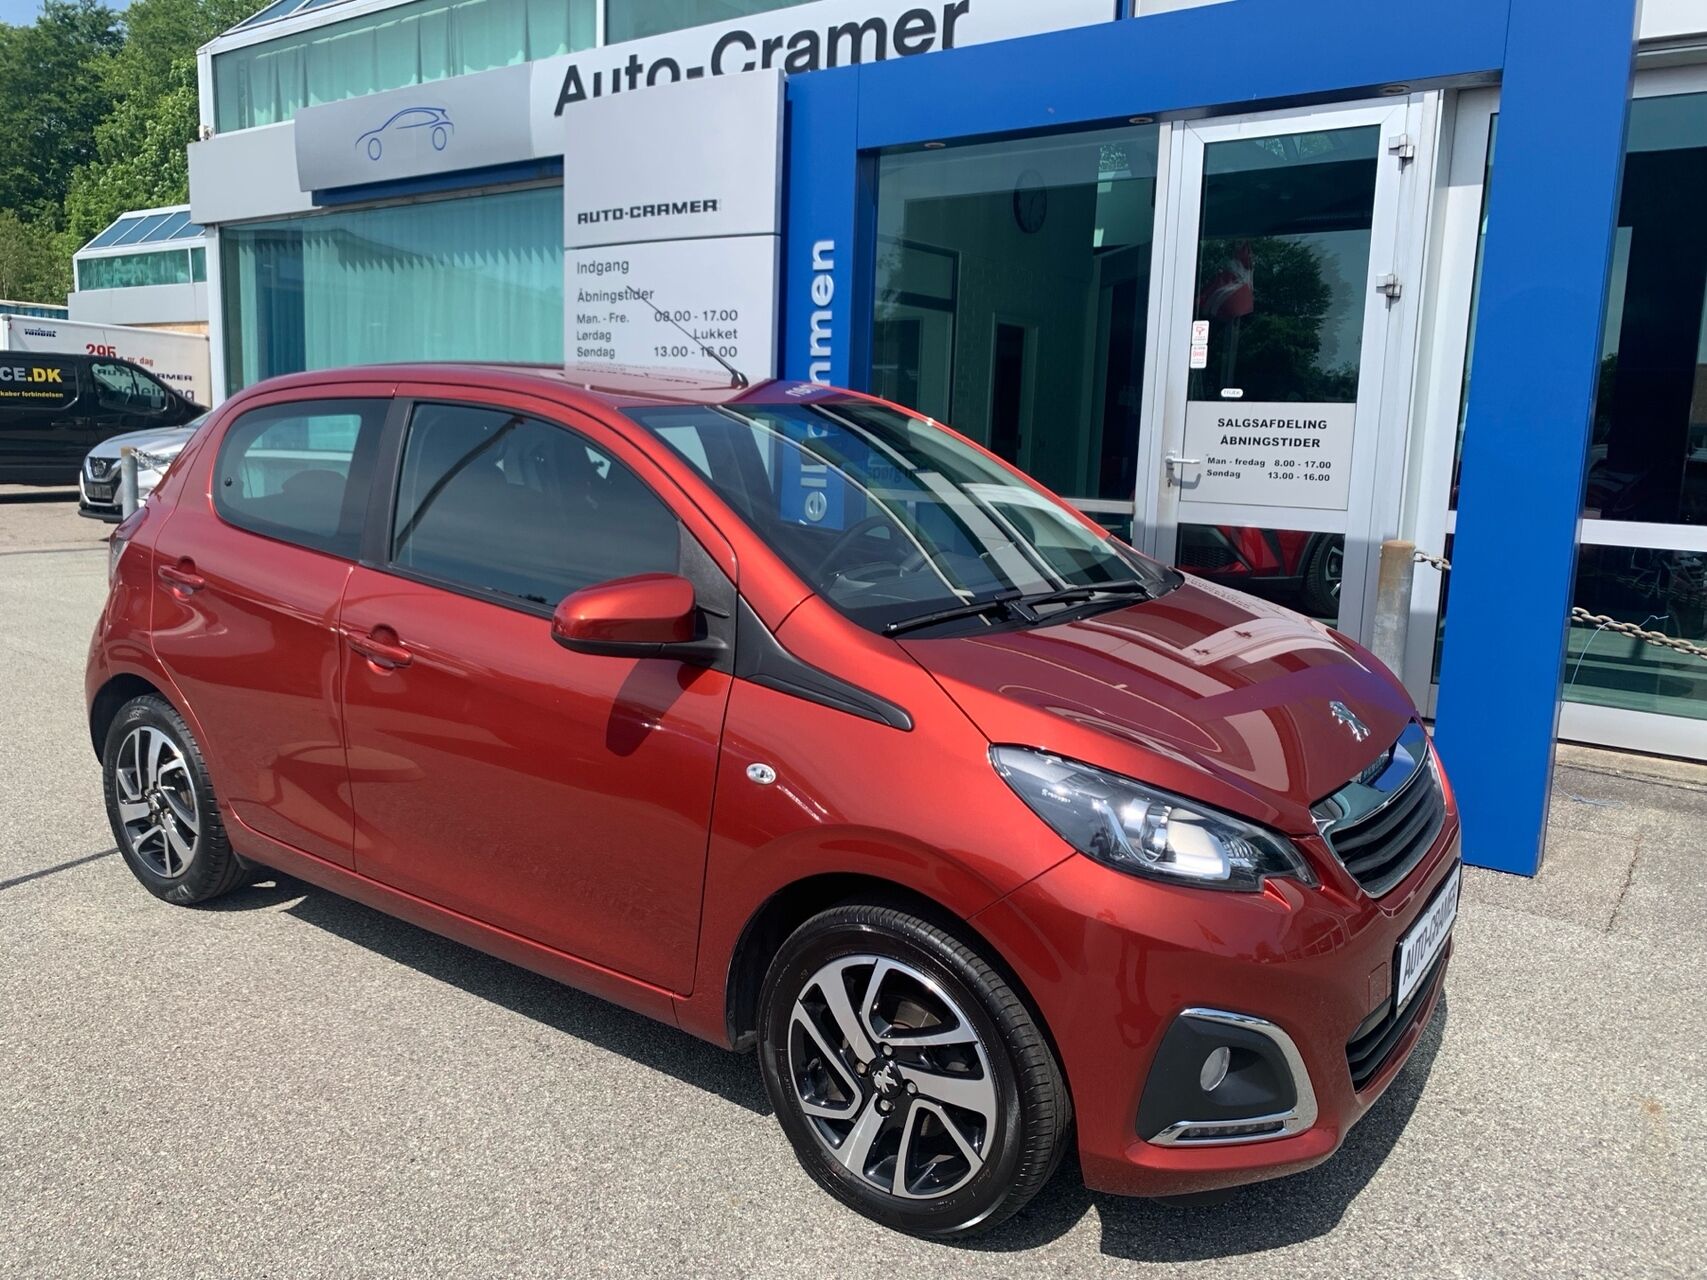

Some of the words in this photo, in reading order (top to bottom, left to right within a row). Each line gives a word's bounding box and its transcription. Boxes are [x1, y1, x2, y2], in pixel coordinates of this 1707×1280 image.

[554, 0, 970, 117] Auto-Cramer
[577, 199, 718, 225] AUTO-CRAMER
[577, 260, 630, 276] Indgang
[577, 287, 655, 304] Åbningstider
[577, 313, 600, 324] Man.
[609, 312, 630, 323] Fre.
[703, 310, 738, 321] 17.00
[576, 330, 612, 343] Lørdag
[694, 328, 738, 340] Lukket
[576, 346, 615, 359] Søndag
[654, 346, 688, 358] 13.00
[700, 346, 738, 358] 1600
[139, 356, 154, 367] dag
[1217, 418, 1328, 430] SALGSAFDELING
[1220, 434, 1321, 448] ÅBNINGSTIDER
[1207, 457, 1227, 465] Man
[1235, 458, 1266, 468] fredag
[1274, 459, 1295, 468] 8.00
[1304, 460, 1331, 469] 17.00
[1268, 472, 1294, 480] 13.00
[1303, 473, 1330, 482] 16.00
